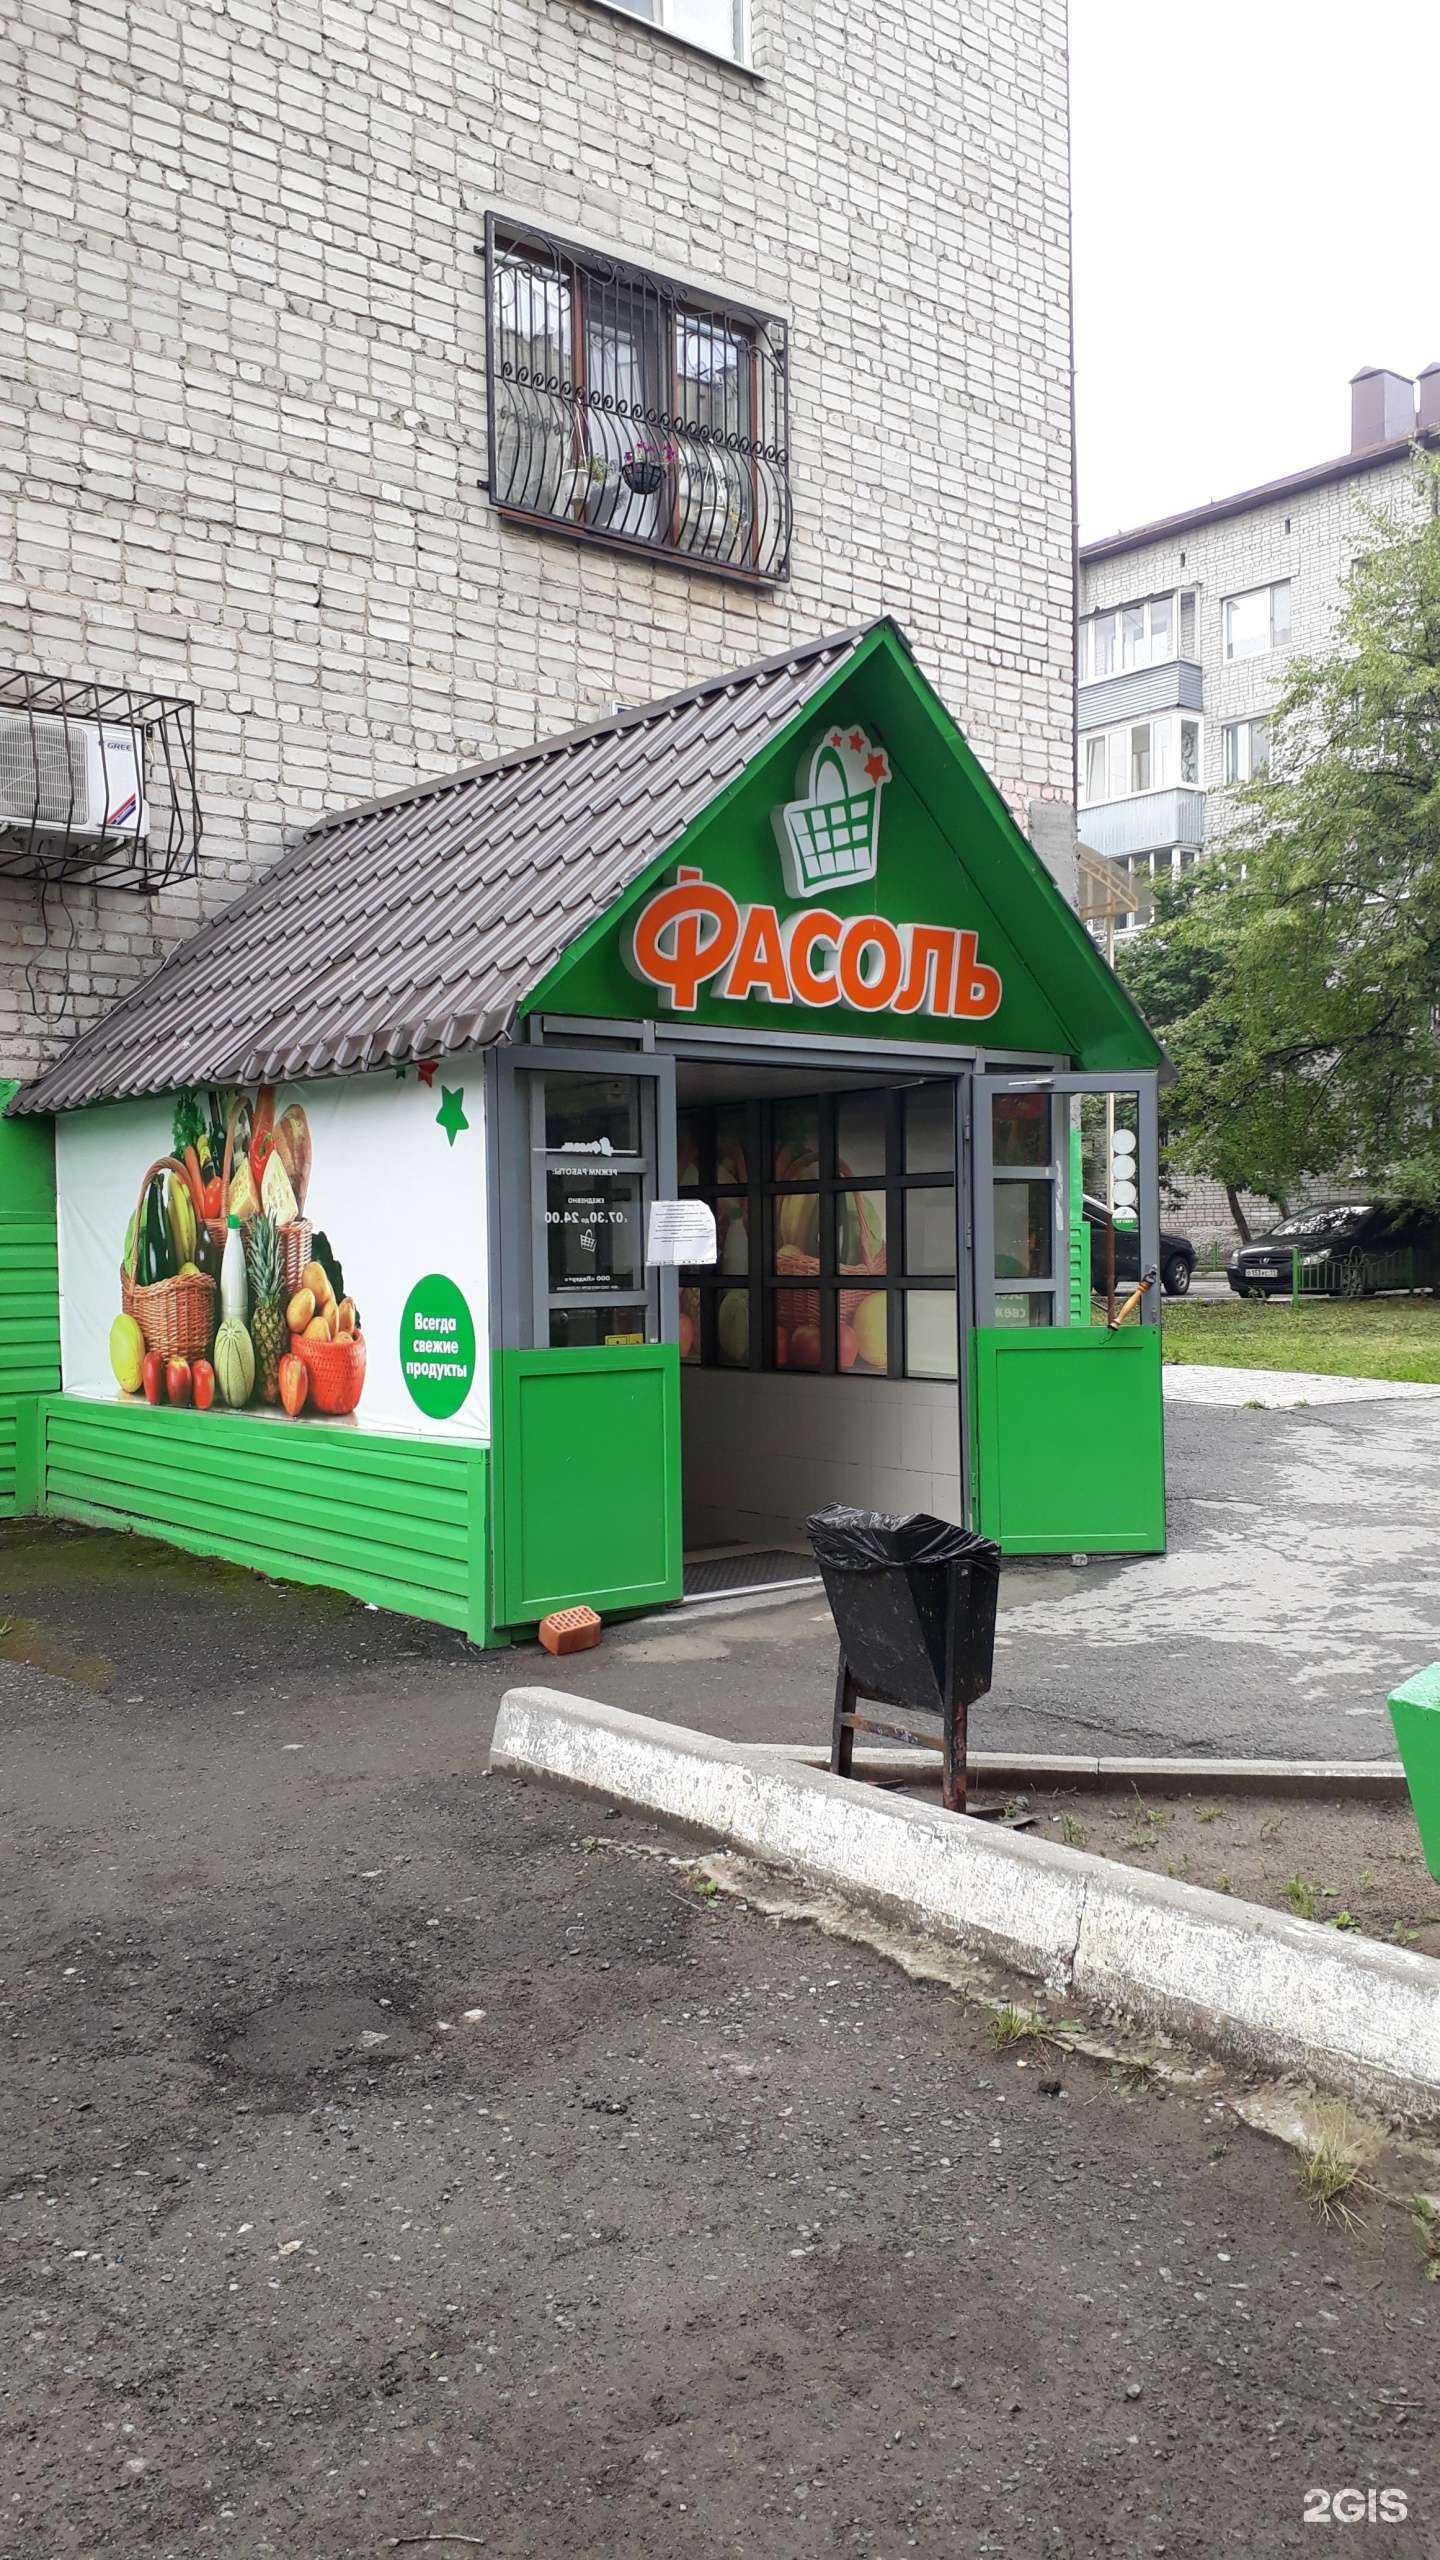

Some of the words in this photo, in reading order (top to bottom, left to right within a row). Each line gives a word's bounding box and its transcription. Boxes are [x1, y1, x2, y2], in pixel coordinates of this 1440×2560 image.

[630, 865, 1002, 1020] ФАСОЛЬ
[414, 1312, 456, 1333] Всегда
[413, 1339, 458, 1354] свежие
[406, 1361, 467, 1381] продукты
